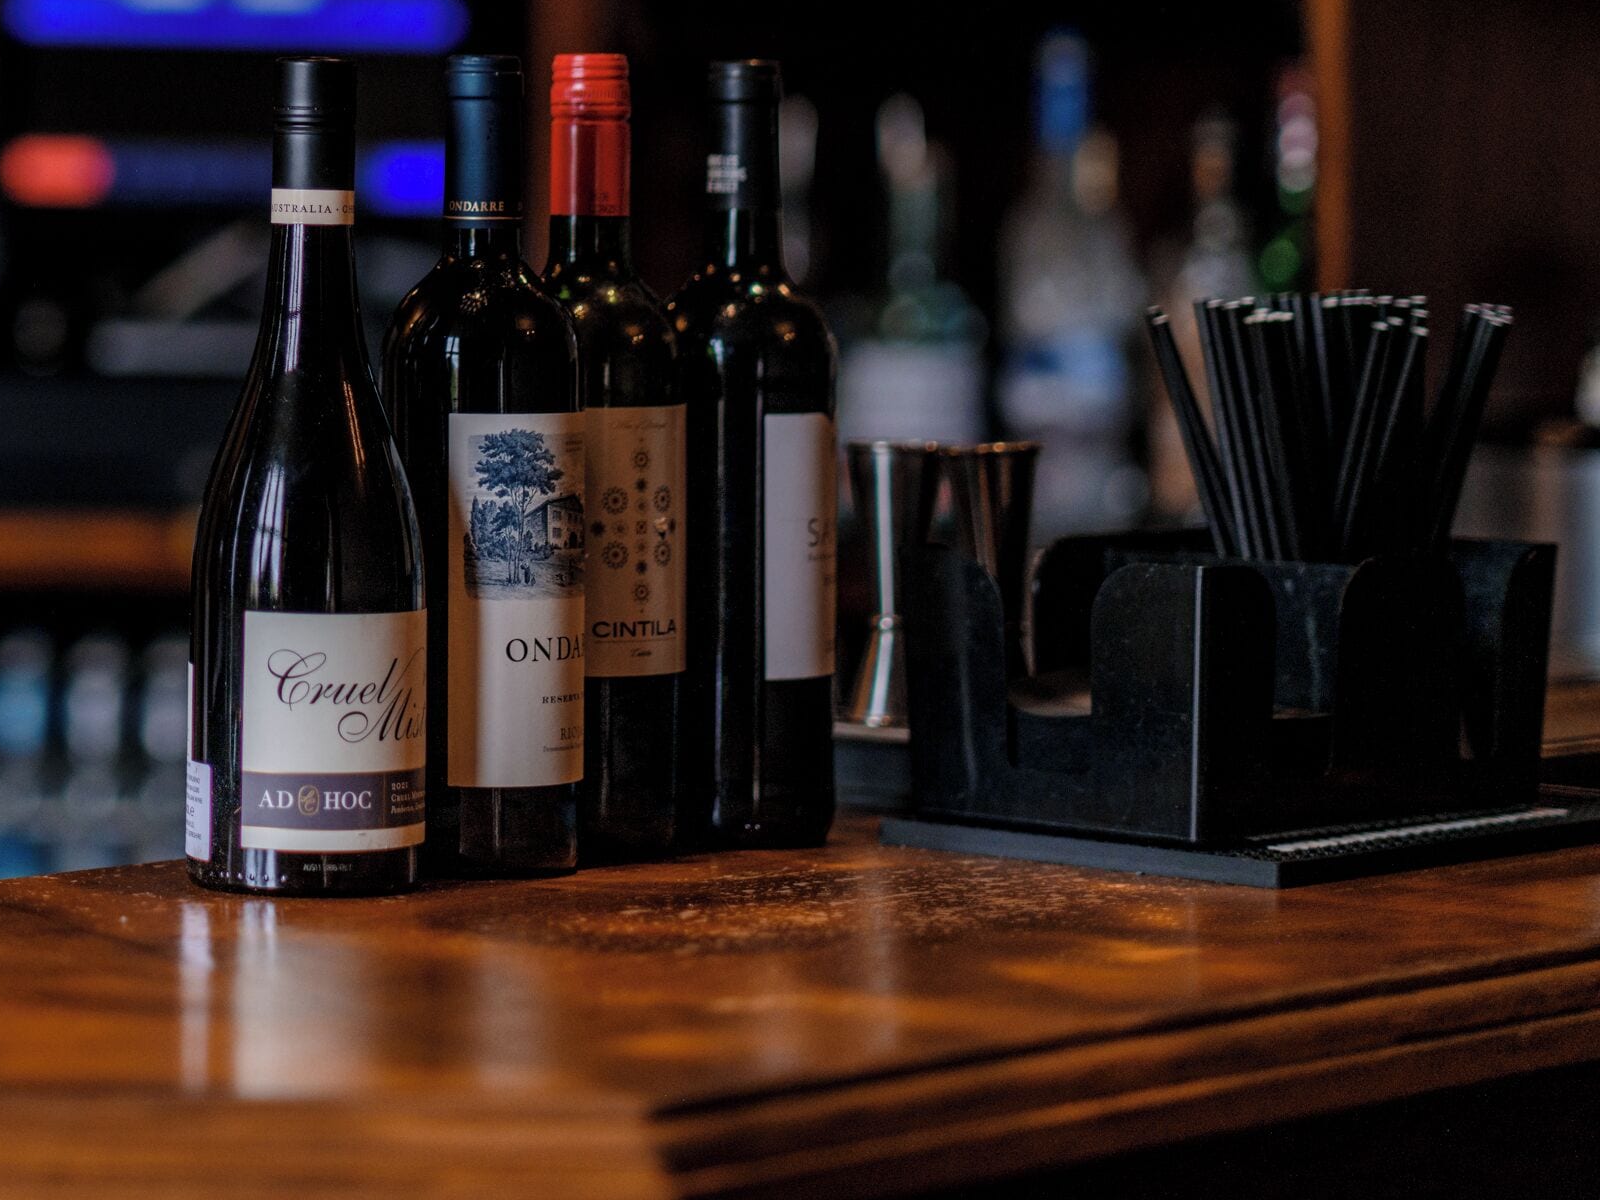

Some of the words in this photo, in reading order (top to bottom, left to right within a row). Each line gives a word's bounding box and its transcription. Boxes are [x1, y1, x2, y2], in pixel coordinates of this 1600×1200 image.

[592, 619, 676, 638] CINTILA
[267, 649, 398, 711] Cruel
[258, 790, 293, 809] AD
[323, 791, 372, 809] HOC
